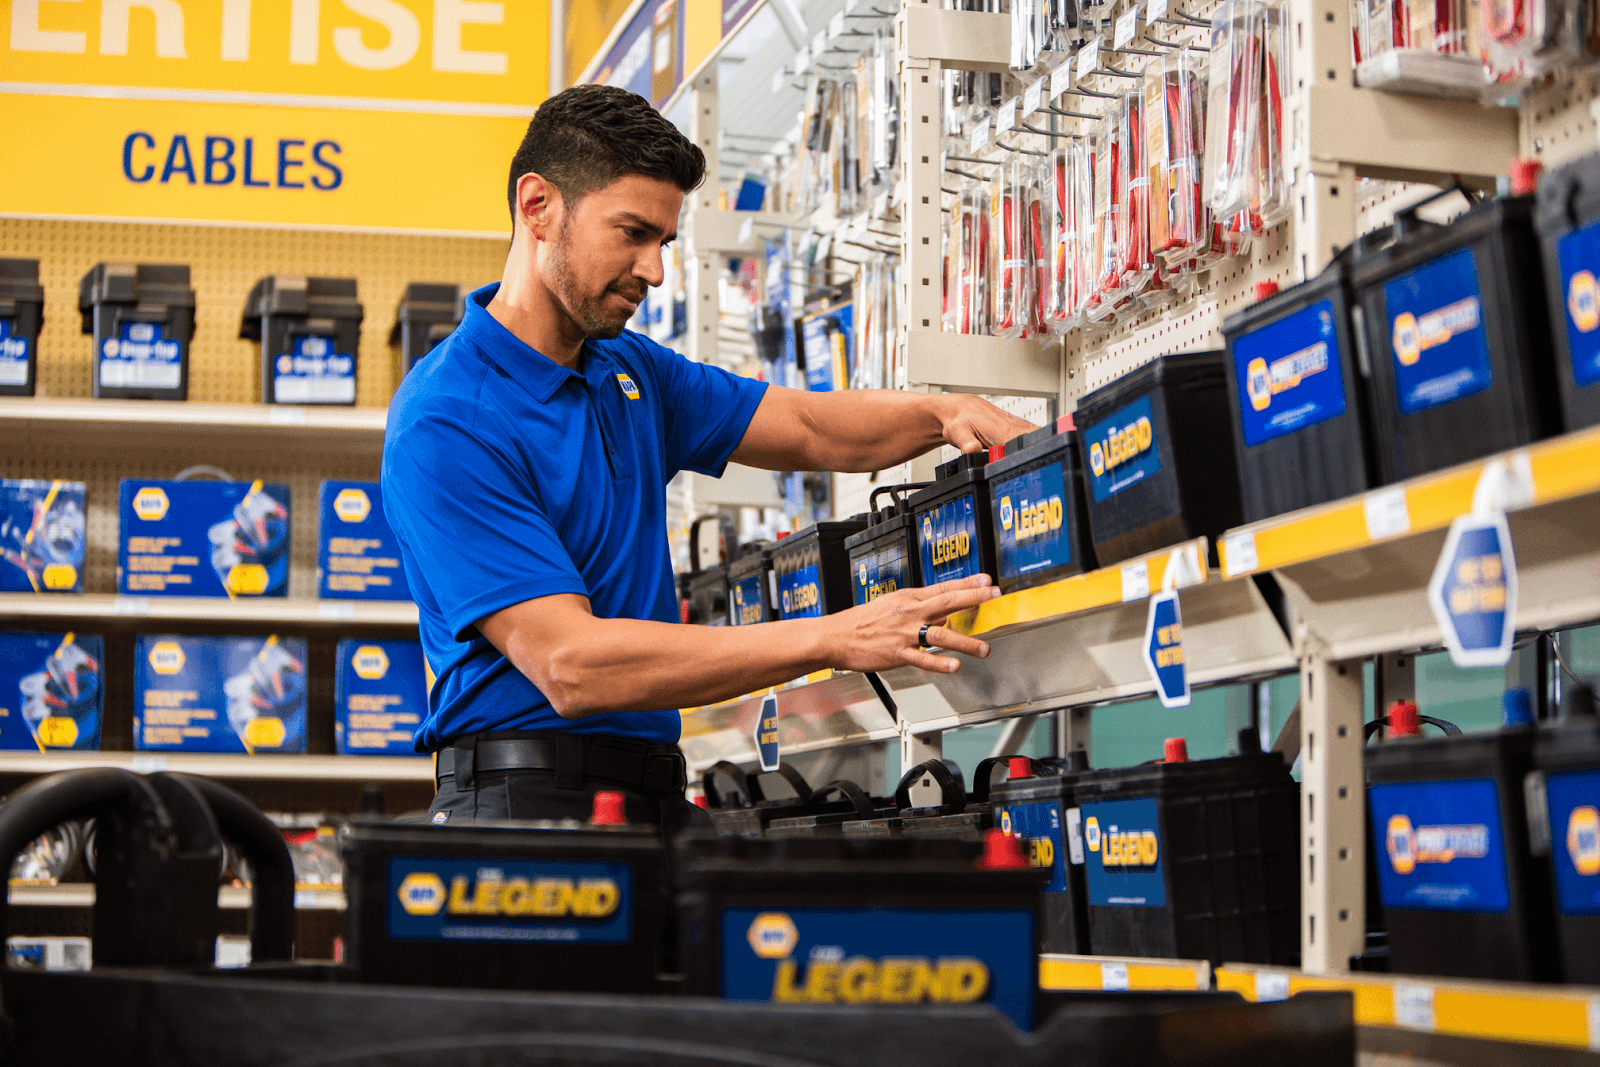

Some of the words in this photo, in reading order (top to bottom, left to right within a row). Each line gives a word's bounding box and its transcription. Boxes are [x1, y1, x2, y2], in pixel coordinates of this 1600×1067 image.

[122, 130, 344, 191] CABLES
[1102, 415, 1152, 470] LEGEND
[1014, 496, 1063, 541] LEGEND
[932, 530, 970, 566] LEGEND
[790, 582, 818, 611] LEGEND
[1029, 836, 1055, 868] END
[1102, 830, 1158, 867] LEGEND
[447, 875, 621, 917] LEGEND
[773, 956, 990, 1004] LEGEND
